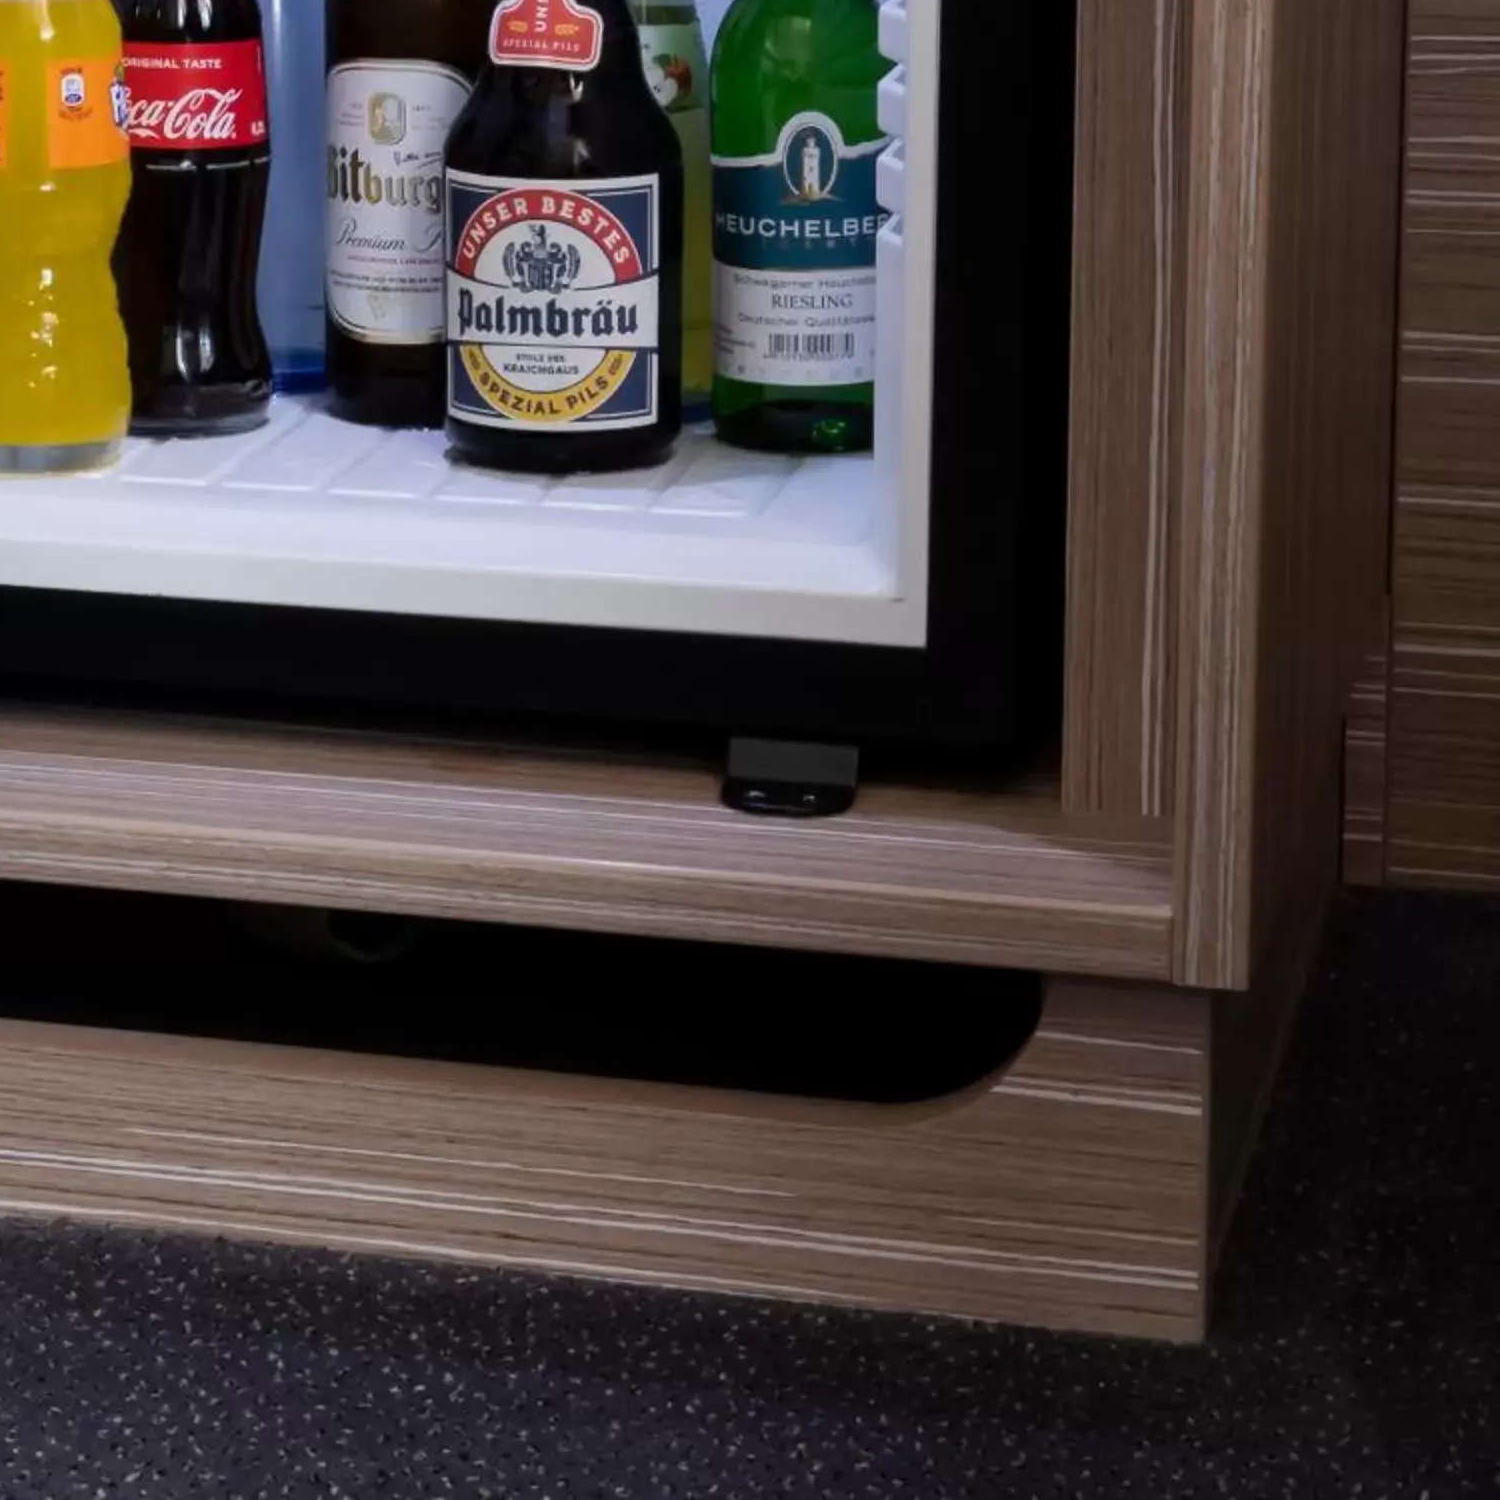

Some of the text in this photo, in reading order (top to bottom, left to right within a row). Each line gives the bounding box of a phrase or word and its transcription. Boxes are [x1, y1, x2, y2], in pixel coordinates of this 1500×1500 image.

[121, 56, 222, 69] ORIGINAL TASTE
[333, 217, 405, 251] Premium
[462, 196, 630, 264] UNSER BESTES
[458, 286, 639, 338] Palmbräu
[771, 293, 853, 310] RIESLING
[479, 371, 610, 416] SPEZIAL PILS
